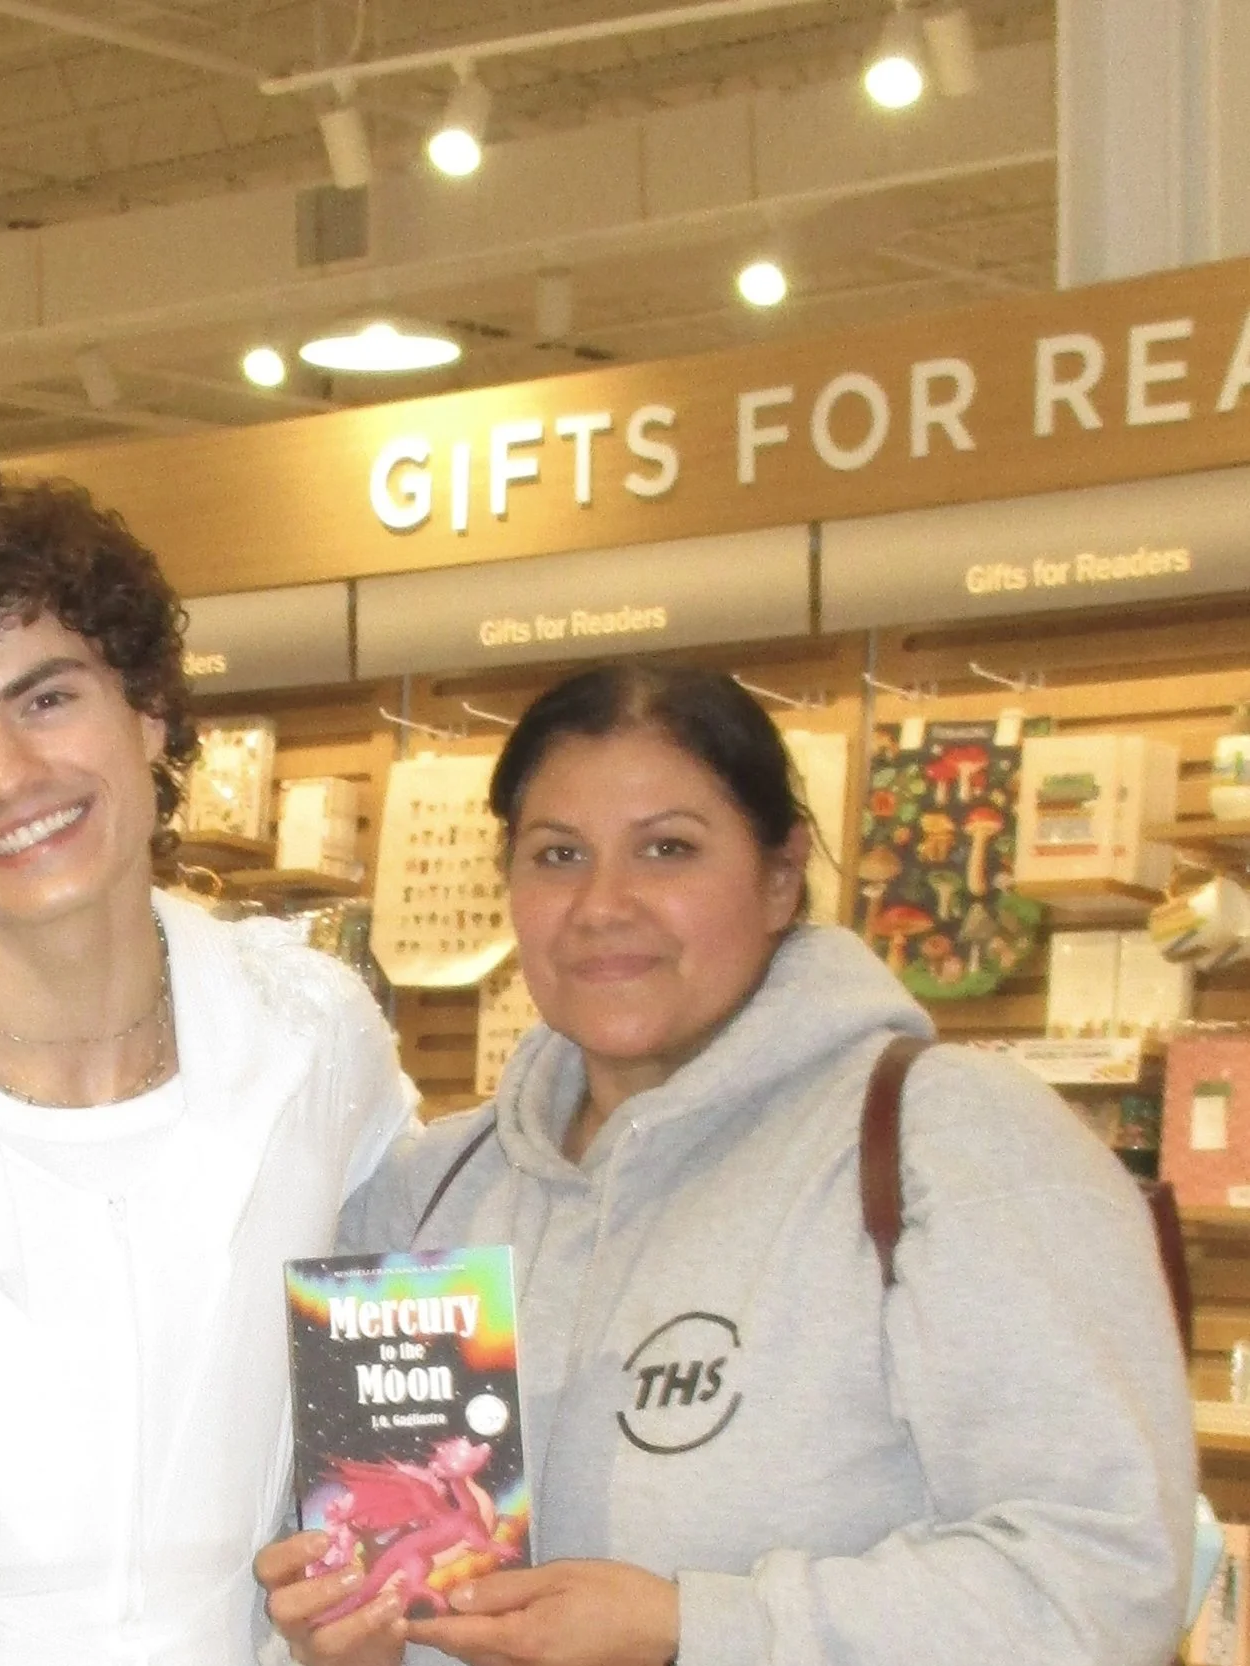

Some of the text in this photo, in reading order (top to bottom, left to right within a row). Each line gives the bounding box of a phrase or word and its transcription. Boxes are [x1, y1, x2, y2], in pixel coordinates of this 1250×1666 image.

[369, 404, 680, 534] GIFTS
[736, 358, 978, 485] FOR
[965, 547, 1192, 594] Gifts for Readers
[479, 605, 667, 646] Gifts for Readers
[328, 1295, 480, 1339] Mercury
[379, 1341, 427, 1361] to the
[355, 1364, 455, 1405] Moon
[635, 1355, 727, 1410] THS
